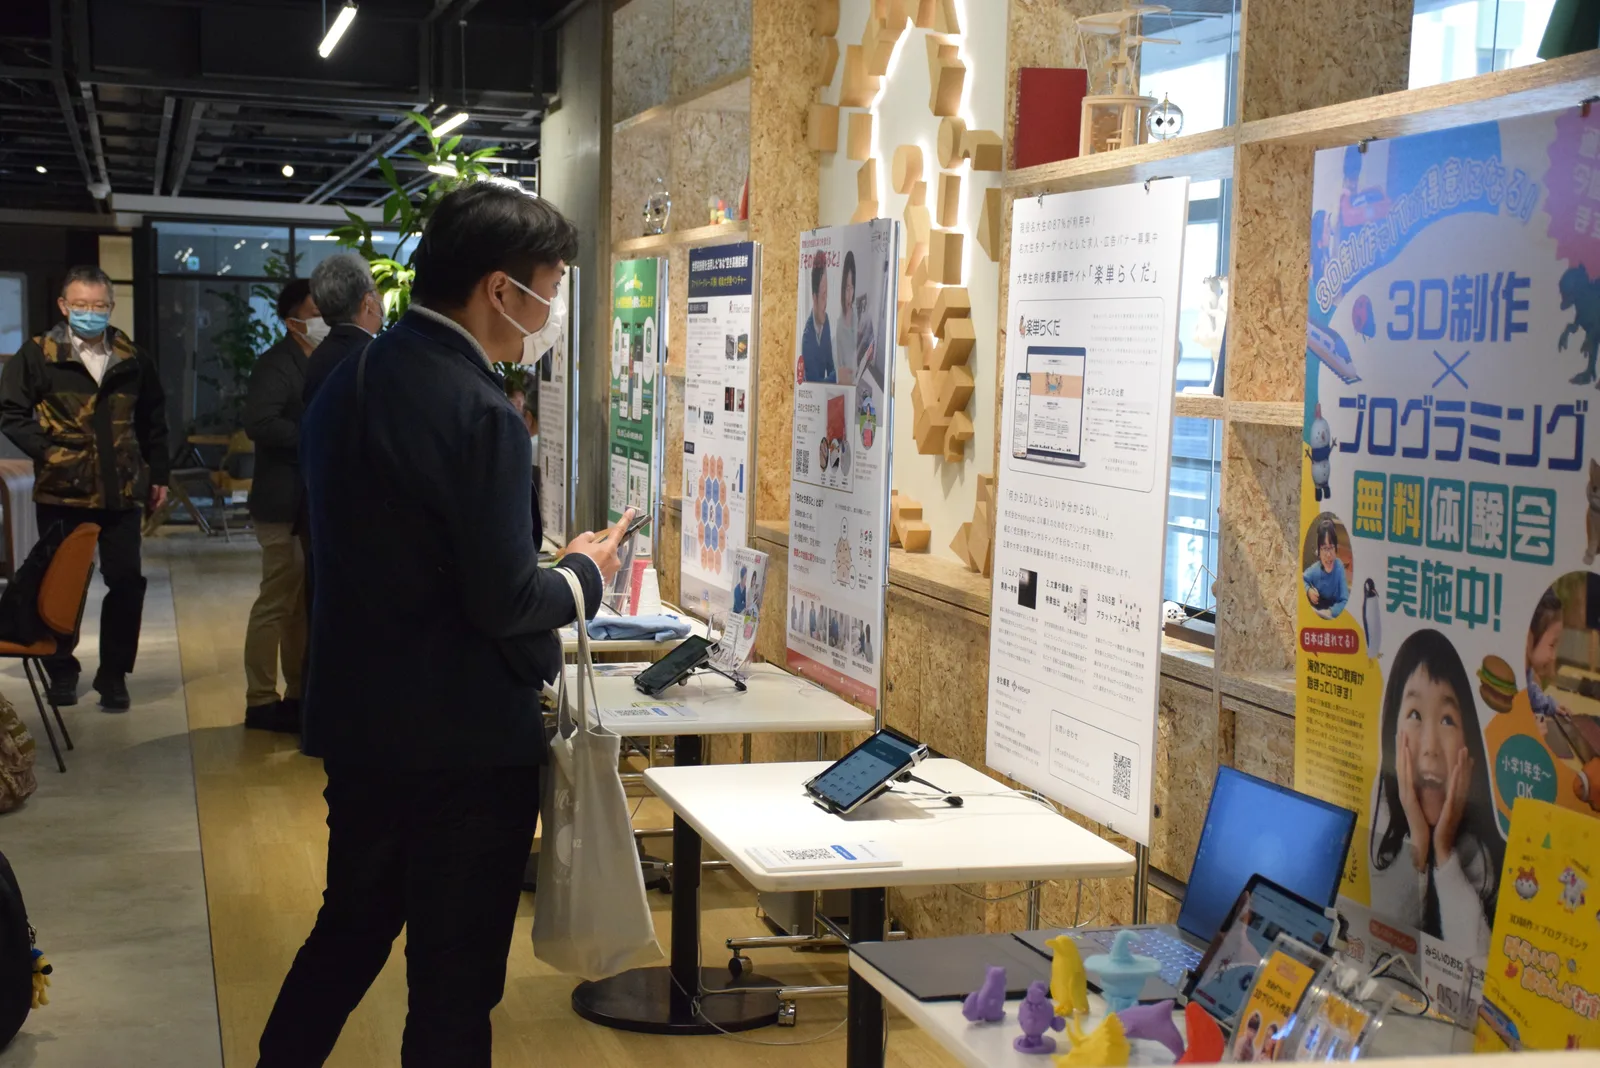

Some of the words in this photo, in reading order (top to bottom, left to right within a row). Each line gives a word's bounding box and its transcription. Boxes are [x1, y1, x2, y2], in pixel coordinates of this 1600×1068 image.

[1386, 271, 1532, 343] 3D制作
[1026, 318, 1061, 337] 楽単らくだ
[1338, 394, 1589, 472] プログラミング
[1355, 477, 1552, 559] 無料体験会
[1386, 555, 1503, 633] 実施中!
[1304, 631, 1355, 648] 日本は遅れてる!
[1307, 658, 1364, 686] 海外では3D教育が
[1307, 675, 1353, 701] 始まっています!
[1516, 781, 1534, 799] OK
